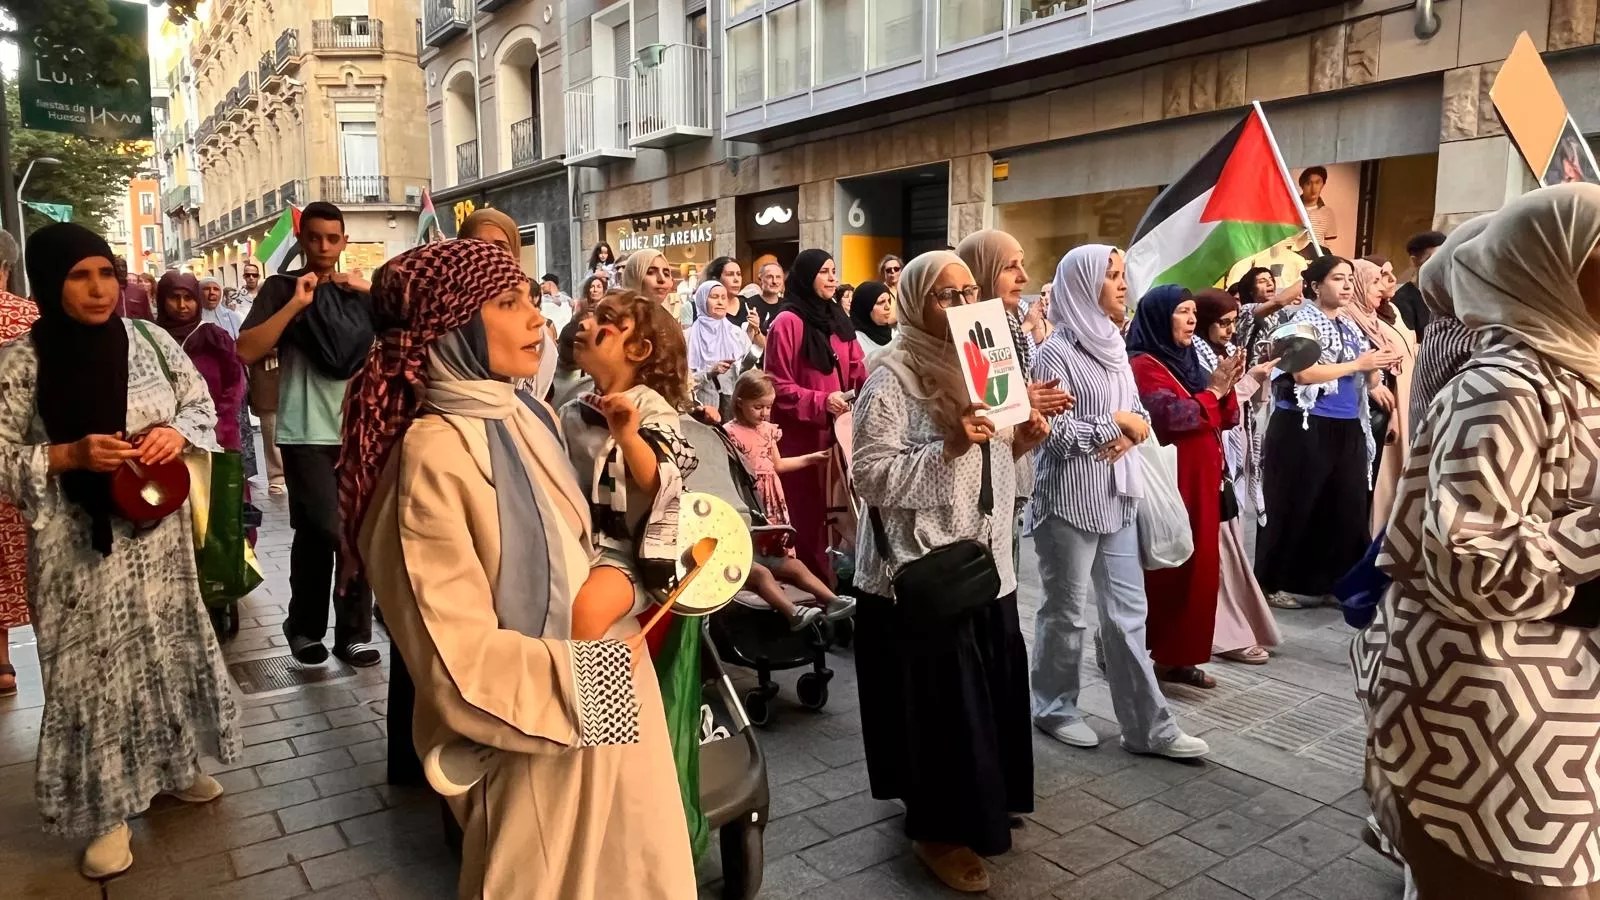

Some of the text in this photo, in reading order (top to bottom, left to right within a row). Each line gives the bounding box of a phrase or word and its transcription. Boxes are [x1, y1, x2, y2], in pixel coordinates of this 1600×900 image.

[72, 103, 85, 112] de
[48, 111, 86, 123] Huesca
[848, 198, 865, 228] 6
[652, 233, 666, 247] DE
[669, 227, 712, 246] ARENAS
[989, 347, 1011, 362] STOP
